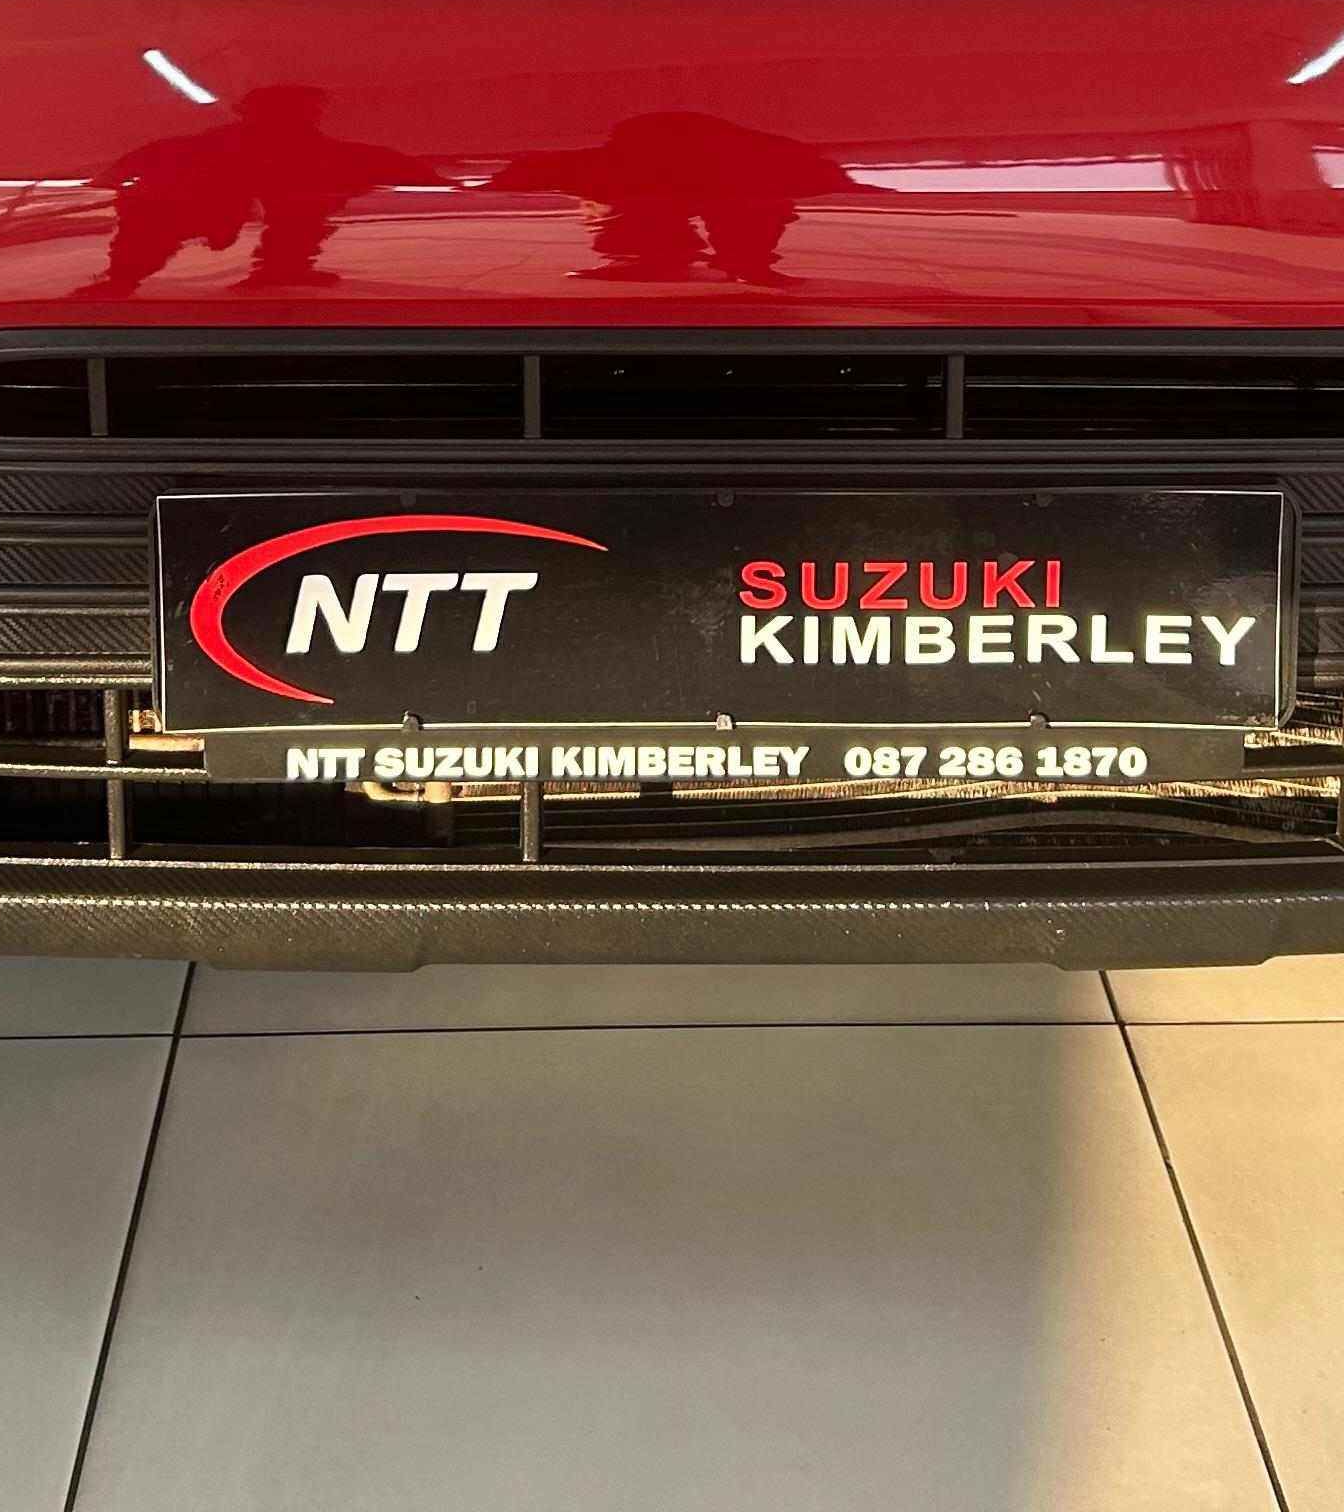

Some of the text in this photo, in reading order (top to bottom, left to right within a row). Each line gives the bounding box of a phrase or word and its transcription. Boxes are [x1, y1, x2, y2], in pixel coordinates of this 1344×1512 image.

[739, 560, 1061, 610] SUZUKI
[285, 572, 538, 654] NTT
[740, 614, 1256, 666] KIMBERLEY
[286, 745, 1148, 779] NTT SUZUKI KIMBERLEY 087 286 1870
